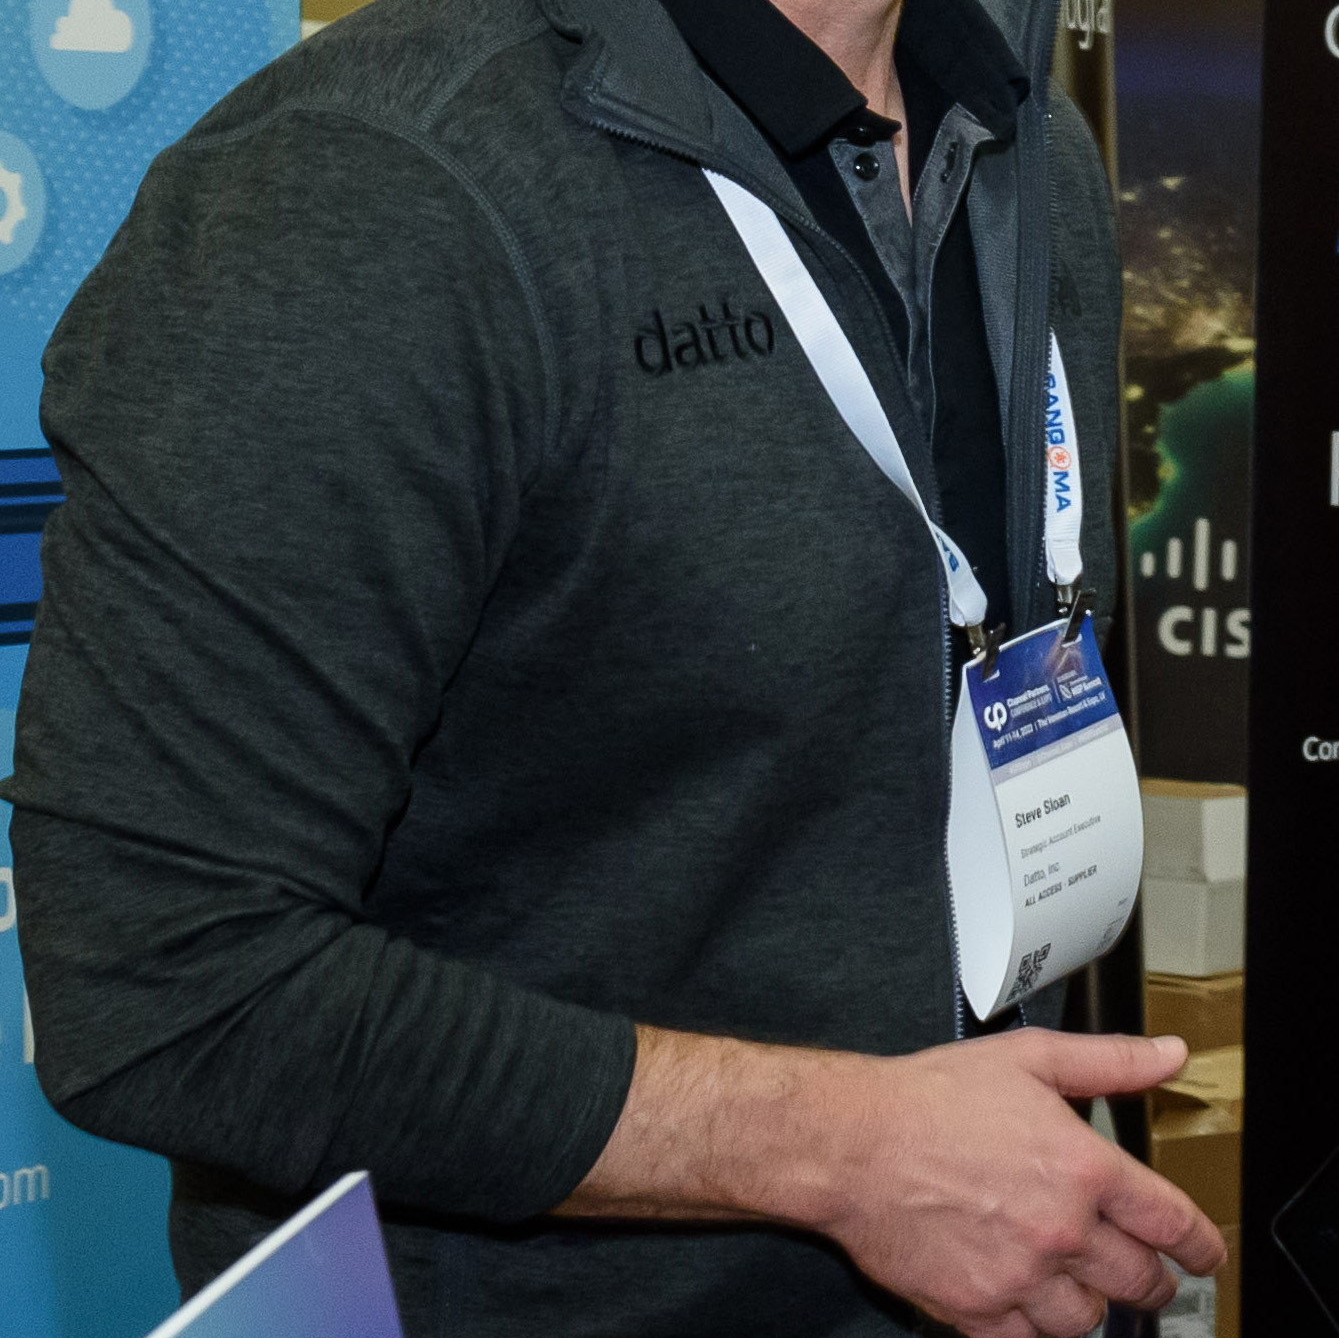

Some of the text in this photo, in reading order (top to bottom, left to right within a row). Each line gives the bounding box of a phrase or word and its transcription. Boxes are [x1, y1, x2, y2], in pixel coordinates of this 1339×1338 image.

[632, 302, 776, 379] datto
[1015, 793, 1071, 829] Steve Sloan
[1025, 864, 1098, 907] ALL ACCESS SUPPLIER
